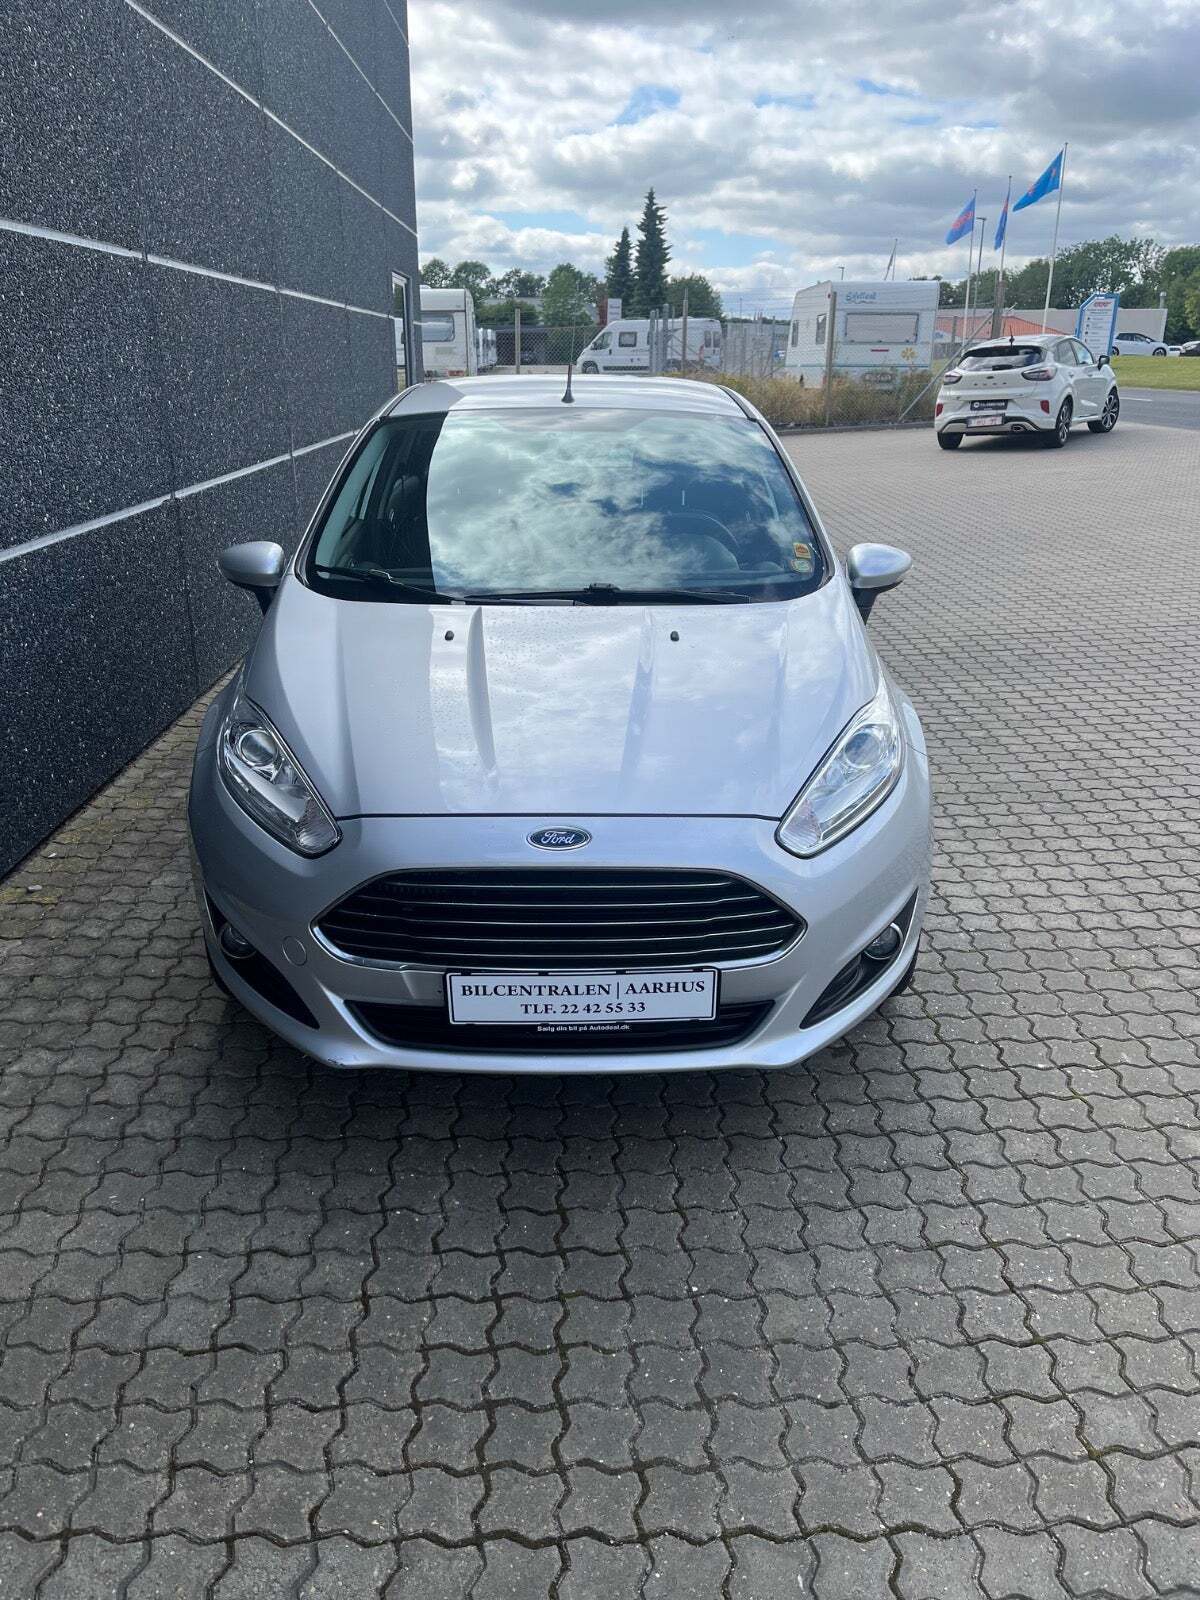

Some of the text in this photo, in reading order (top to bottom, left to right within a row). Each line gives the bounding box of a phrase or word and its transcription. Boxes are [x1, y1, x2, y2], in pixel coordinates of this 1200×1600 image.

[541, 830, 575, 844] Ford
[461, 981, 705, 996] BILCENTRALEN AARHUS
[520, 1002, 646, 1014] TLF. 22 42 55 33
